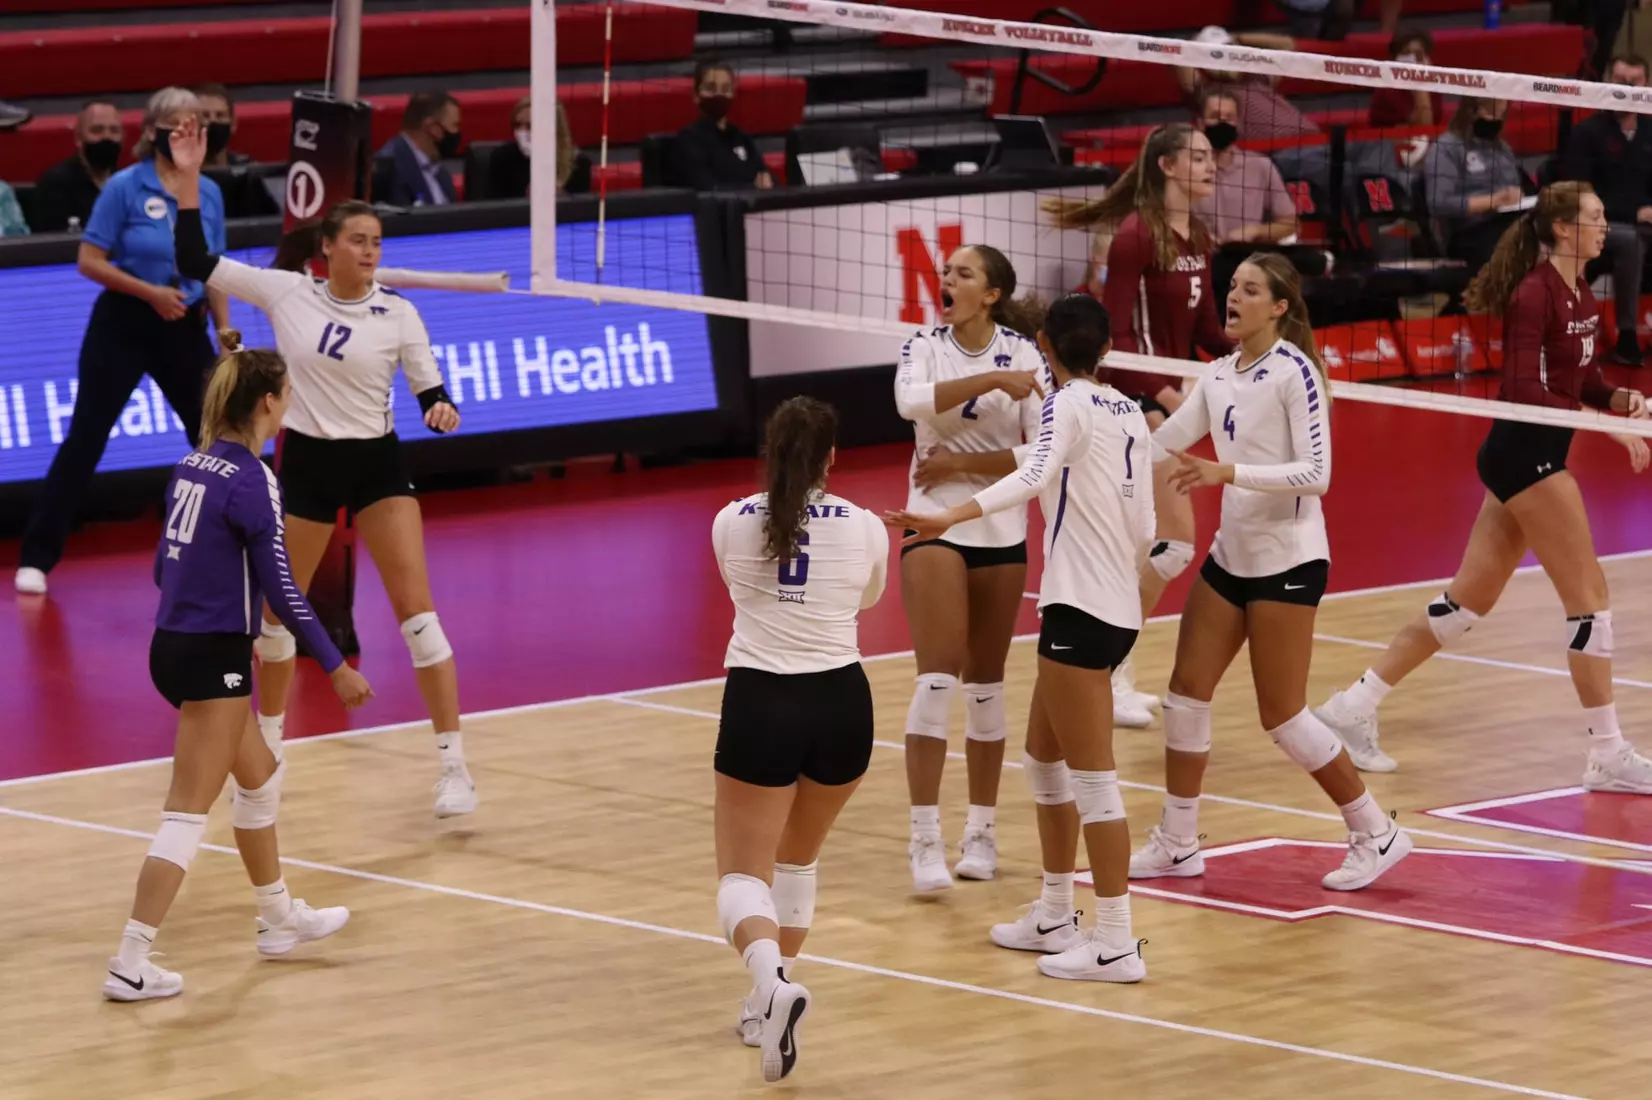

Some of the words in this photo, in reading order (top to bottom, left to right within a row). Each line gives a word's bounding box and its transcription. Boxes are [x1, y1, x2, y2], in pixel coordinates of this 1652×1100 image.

[942, 18, 997, 36] HUSKER
[1004, 26, 1093, 47] VOLLEYBALL
[1324, 60, 1382, 78] HUSKER
[1390, 67, 1487, 88] VOLLEYBALL
[1533, 82, 1582, 96] BEARDMORE
[1363, 178, 1394, 213] N
[1188, 276, 1202, 308] 5
[317, 322, 353, 361] 12
[431, 339, 502, 404] HI
[512, 321, 674, 397] Health
[1223, 404, 1236, 441] 4
[1122, 428, 1135, 479] 1
[165, 478, 207, 544] 20
[738, 502, 850, 518] K-ATE
[777, 530, 810, 586] 6
